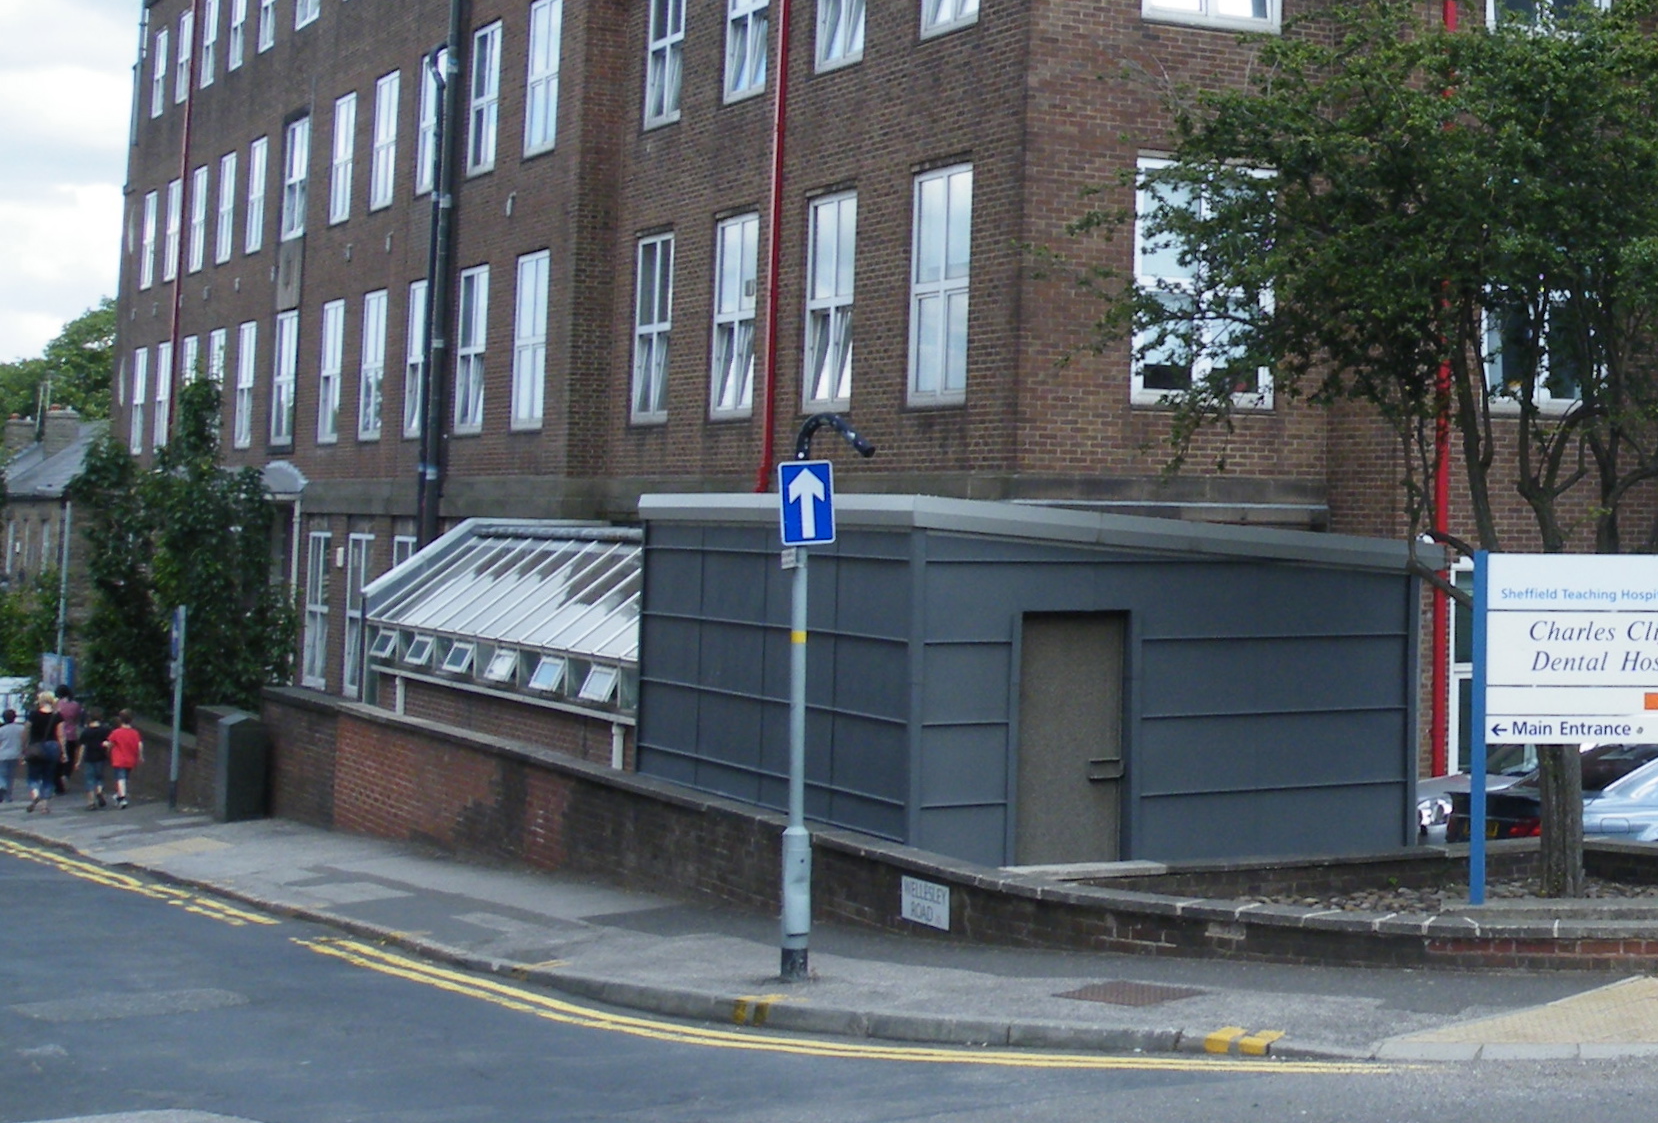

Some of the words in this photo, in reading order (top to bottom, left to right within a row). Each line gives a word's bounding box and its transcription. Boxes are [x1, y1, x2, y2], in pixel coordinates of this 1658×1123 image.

[1501, 588, 1558, 600] Sheffield
[1563, 588, 1617, 603] Teaching
[1529, 620, 1616, 642] Charles
[1531, 650, 1609, 673] Dental
[1511, 721, 1553, 736] Main
[1559, 721, 1632, 736] Entrance
[910, 901, 934, 922] ROAD
